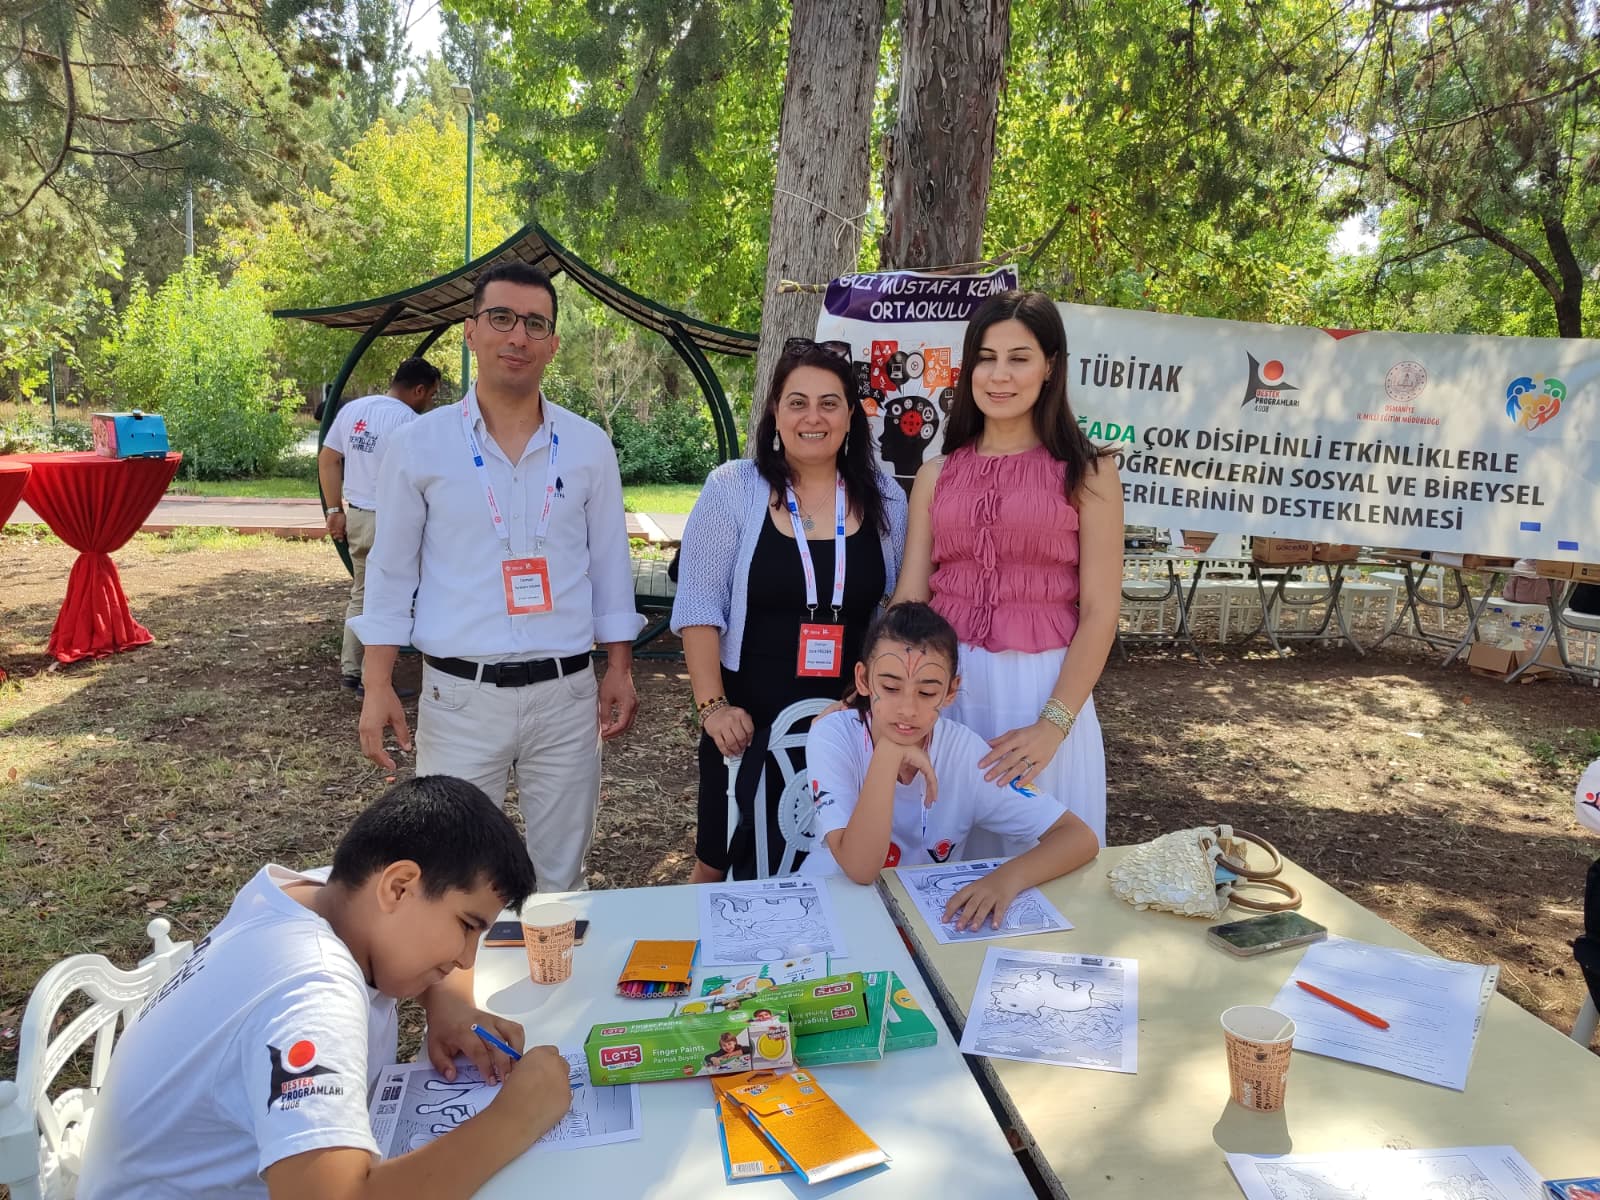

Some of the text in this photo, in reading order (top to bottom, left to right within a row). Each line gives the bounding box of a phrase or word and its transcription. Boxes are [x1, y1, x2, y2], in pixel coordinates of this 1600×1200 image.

[878, 276, 960, 296] MUSTAFA
[966, 274, 1009, 297] KEMAL
[869, 300, 971, 319] ORTAOKULU
[1079, 353, 1184, 393] TÜBİTAK
[1255, 397, 1300, 407] PROGRAMLARI
[1143, 427, 1191, 450] ÇOK
[1196, 428, 1322, 459] DİSİPLİNLİ
[1328, 440, 1519, 474] ETKİNLİKLERLE
[1290, 468, 1379, 494] SOSYAL
[1387, 475, 1417, 497] VE
[1424, 476, 1545, 506] BİREYSEL
[1262, 495, 1463, 530] DESTEKLENMESİ
[652, 1048, 678, 1058] Finger
[680, 1045, 705, 1054] Paints
[281, 1077, 314, 1093] DESTEK
[281, 1086, 344, 1102] PROGRAMLARI
